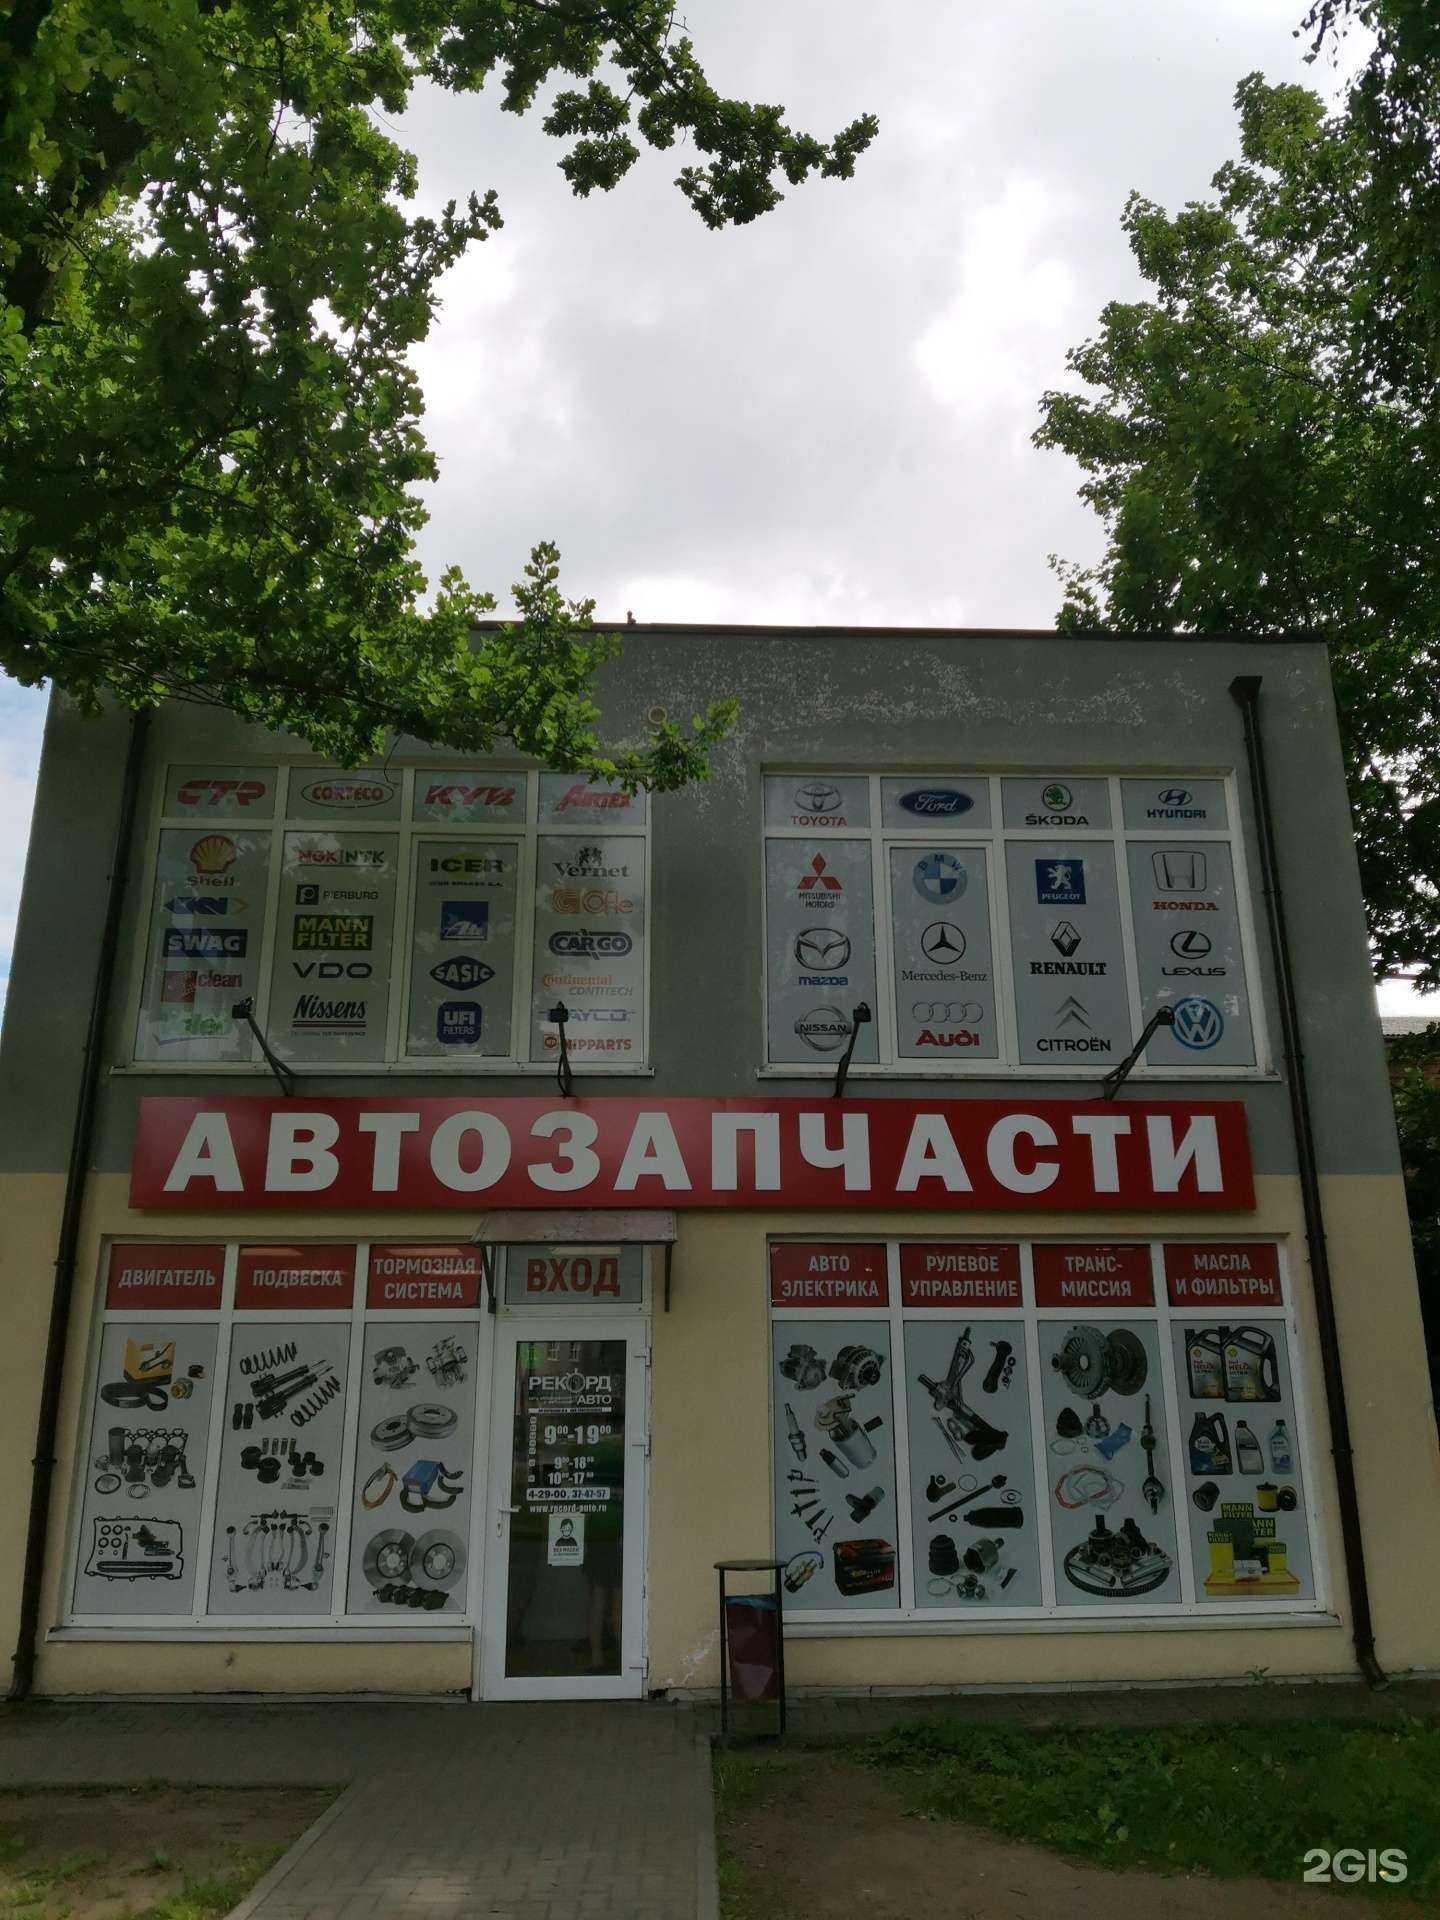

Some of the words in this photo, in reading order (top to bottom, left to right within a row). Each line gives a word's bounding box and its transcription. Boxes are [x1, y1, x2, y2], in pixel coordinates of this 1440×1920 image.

[311, 787, 384, 801] CORTECO
[914, 792, 957, 813] Ford
[791, 815, 847, 826] TOYOTA
[1147, 809, 1207, 819] HYUNDAI
[430, 858, 504, 873] ICER
[553, 861, 632, 878] Vernet
[188, 874, 236, 888] Shell
[798, 892, 842, 901] MITSUBISHI
[1041, 892, 1082, 901] PEUGEOT
[805, 900, 836, 909] MOTORS
[1152, 901, 1220, 912] HONDA
[298, 918, 369, 932] MANN
[168, 934, 241, 952] SWAG
[296, 933, 368, 947] FILTER
[553, 936, 627, 951] CARGO
[292, 962, 373, 979] VDO
[434, 963, 491, 983] SASIC
[901, 970, 988, 982] Mercedes-Benz
[1030, 962, 1107, 975] RENAULT
[1162, 967, 1226, 976] LEXUS
[543, 974, 614, 988] Continental
[569, 986, 634, 997] CONTITECH
[293, 994, 368, 1020] Nissens
[556, 1009, 630, 1021] AYCO
[443, 1026, 475, 1036] FILTERS
[799, 1023, 847, 1033] NISSAN
[1036, 1036, 1112, 1052] CITROËN
[162, 1110, 1224, 1194] АВТОЗАПЧАСТИ
[374, 1257, 477, 1276] ТОРМОЗНАЯ
[807, 1255, 850, 1273] АВТО
[925, 1255, 1000, 1273] РУЛЕВОЕ
[1064, 1255, 1124, 1273] ТРАНС-
[1193, 1254, 1251, 1271] МАСЛА
[118, 1268, 216, 1288] ДВИГАТЕЛЬ
[252, 1267, 343, 1289] ПОДВЕСКА
[526, 1257, 620, 1297] ВХОД
[384, 1281, 464, 1300] СИСТЕМА
[781, 1279, 880, 1298] ЭЛЕКТРИКА
[909, 1280, 1019, 1297] УПРАВЛЕНИЕ
[1061, 1280, 1132, 1297] МИССИЯ
[1175, 1279, 1188, 1295] И
[1190, 1277, 1274, 1297] ФИЛЬТРЫ
[528, 1372, 612, 1393] РЕКОРД
[576, 1394, 612, 1406] АВТО
[529, 1503, 607, 1514] www.record-auto.ru
